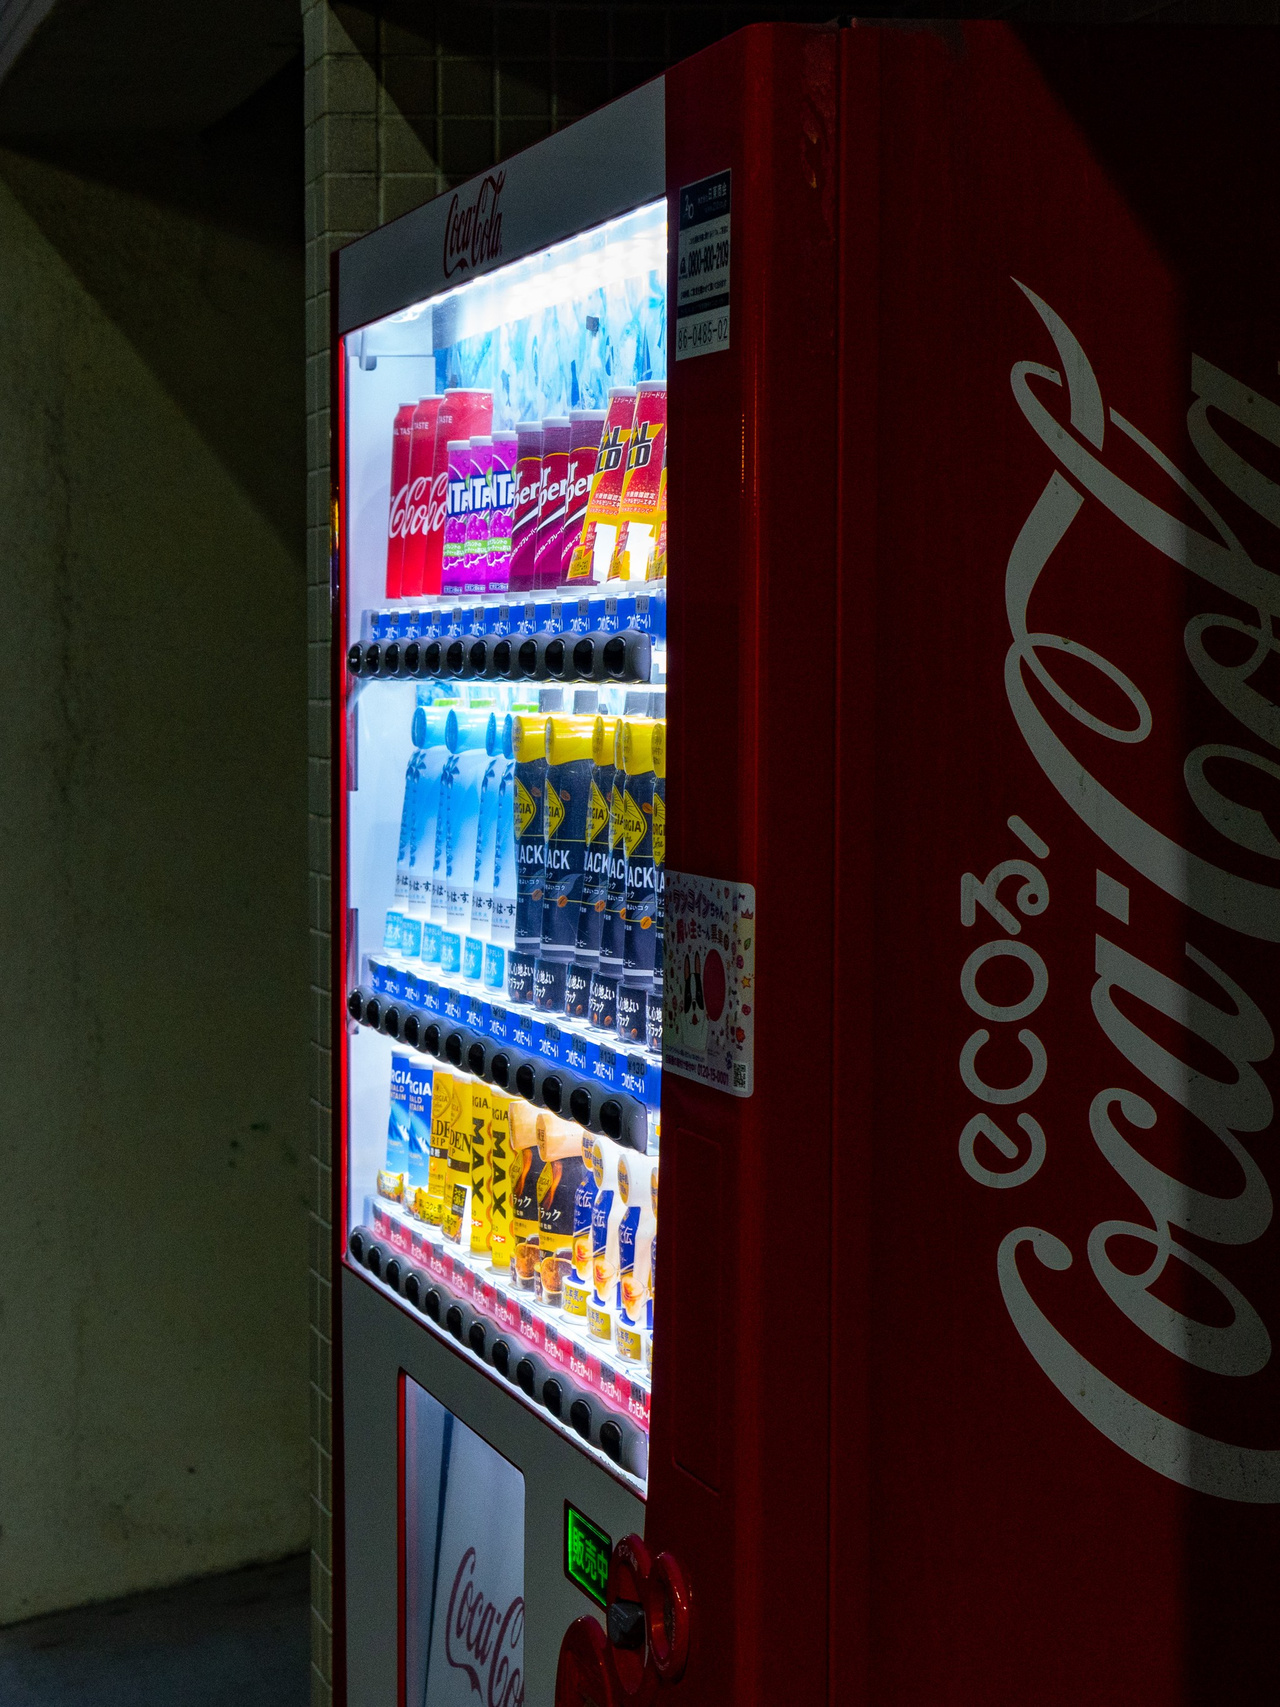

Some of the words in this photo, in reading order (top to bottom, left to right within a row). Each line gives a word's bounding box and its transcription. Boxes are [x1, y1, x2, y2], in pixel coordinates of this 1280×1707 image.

[444, 169, 506, 279] Coca-Cola
[472, 1116, 485, 1204] MAX
[492, 1130, 507, 1219] MAX
[571, 1525, 609, 1589] 販売中
